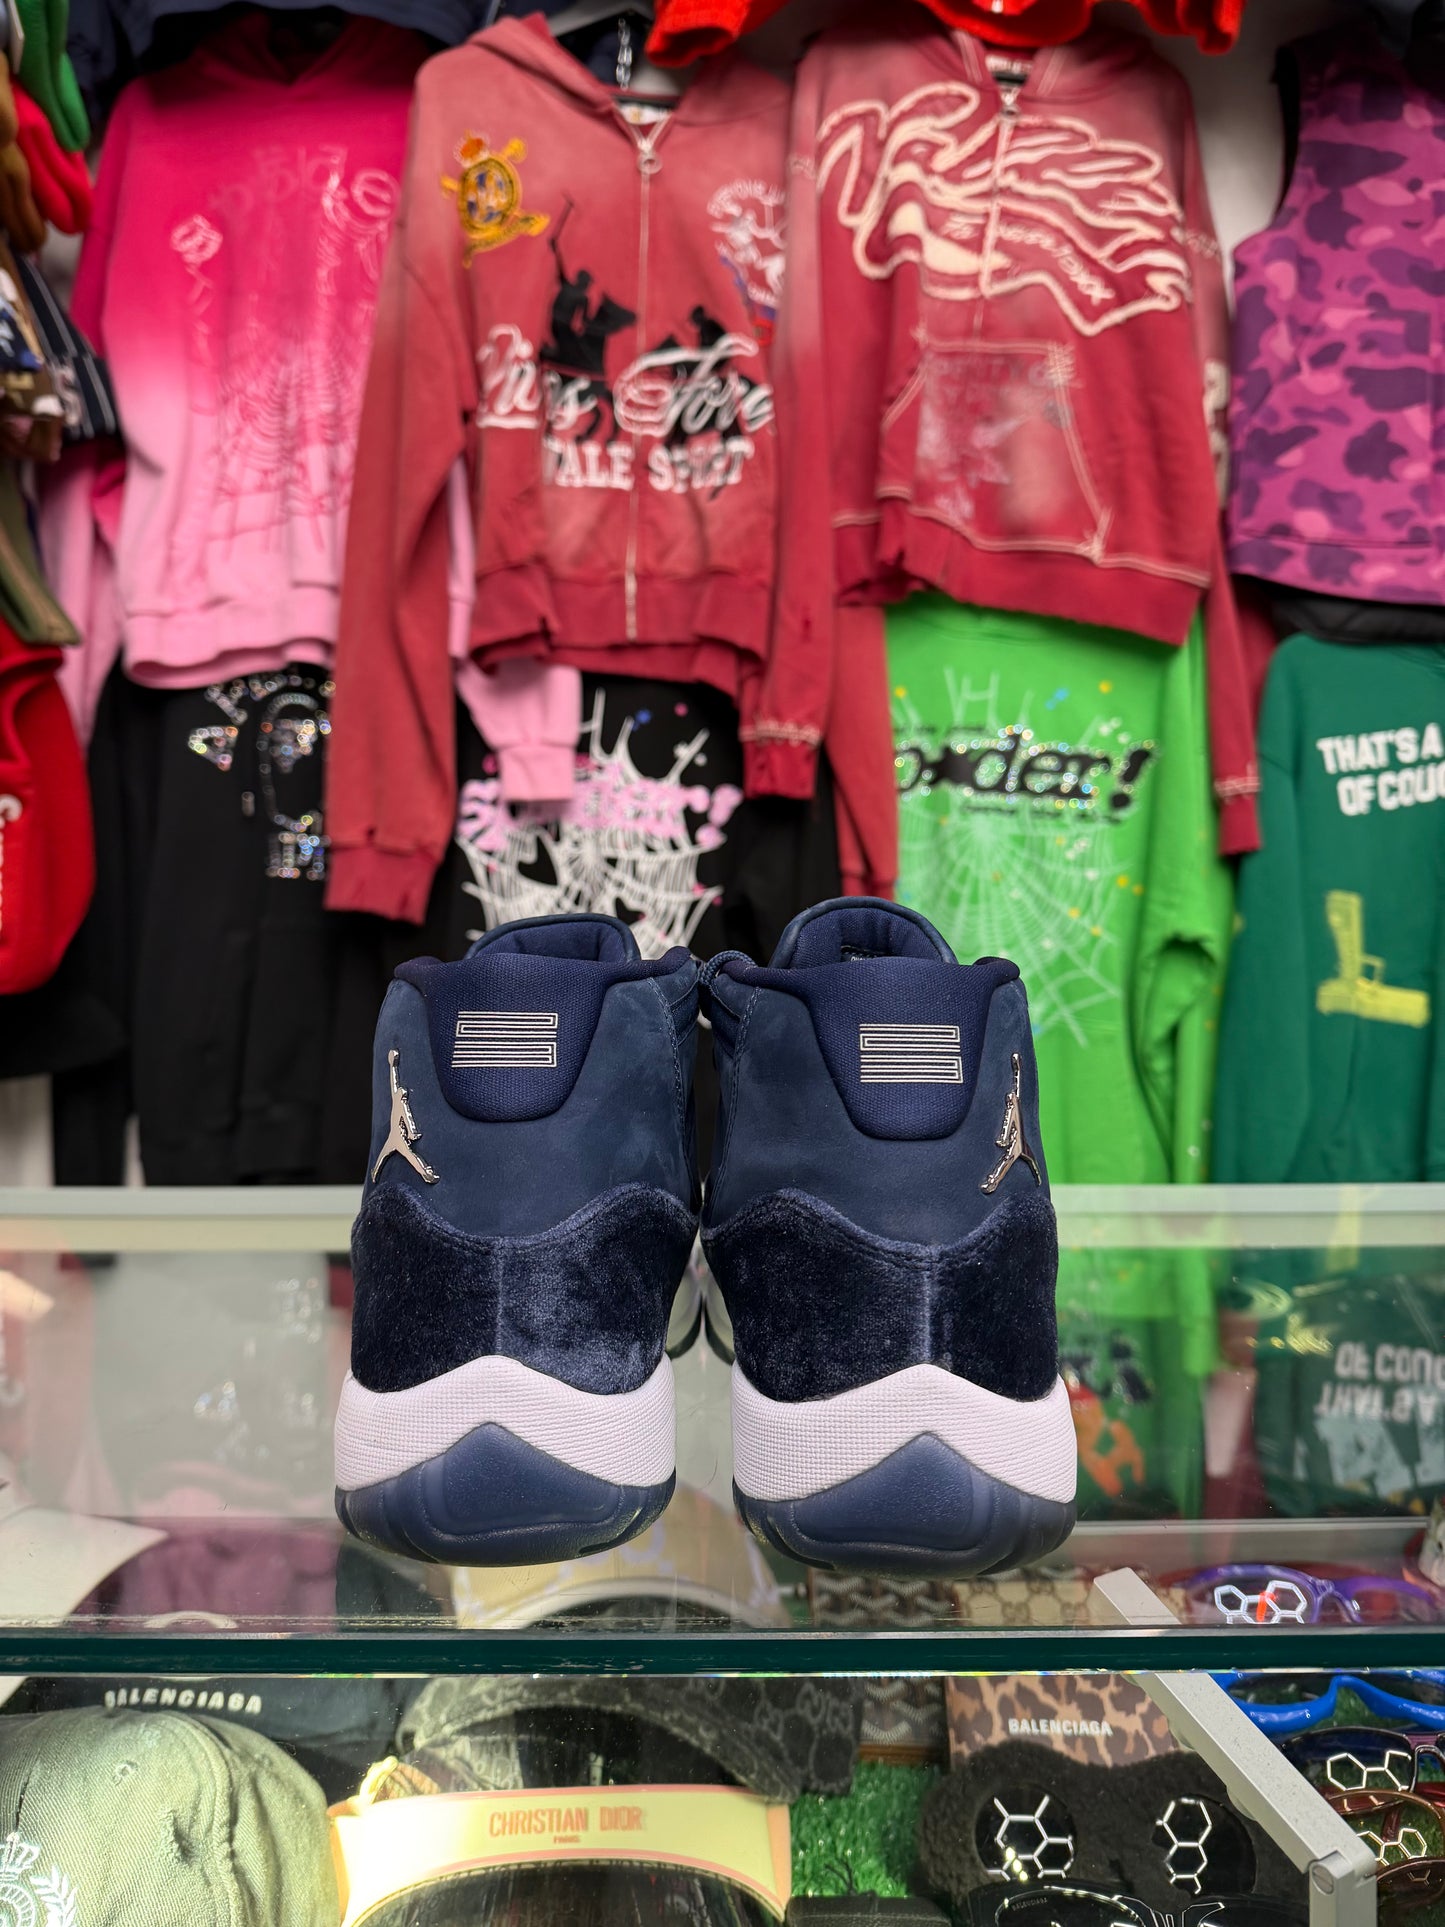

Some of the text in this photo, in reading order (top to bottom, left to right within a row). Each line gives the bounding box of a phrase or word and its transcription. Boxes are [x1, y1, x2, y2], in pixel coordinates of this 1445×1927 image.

[1316, 722, 1444, 775] THAT'S A
[1336, 774, 1376, 816] OF
[1008, 1717, 1114, 1737] BALENCIAGA
[489, 1805, 643, 1838] CHRISTIAN DIOR
